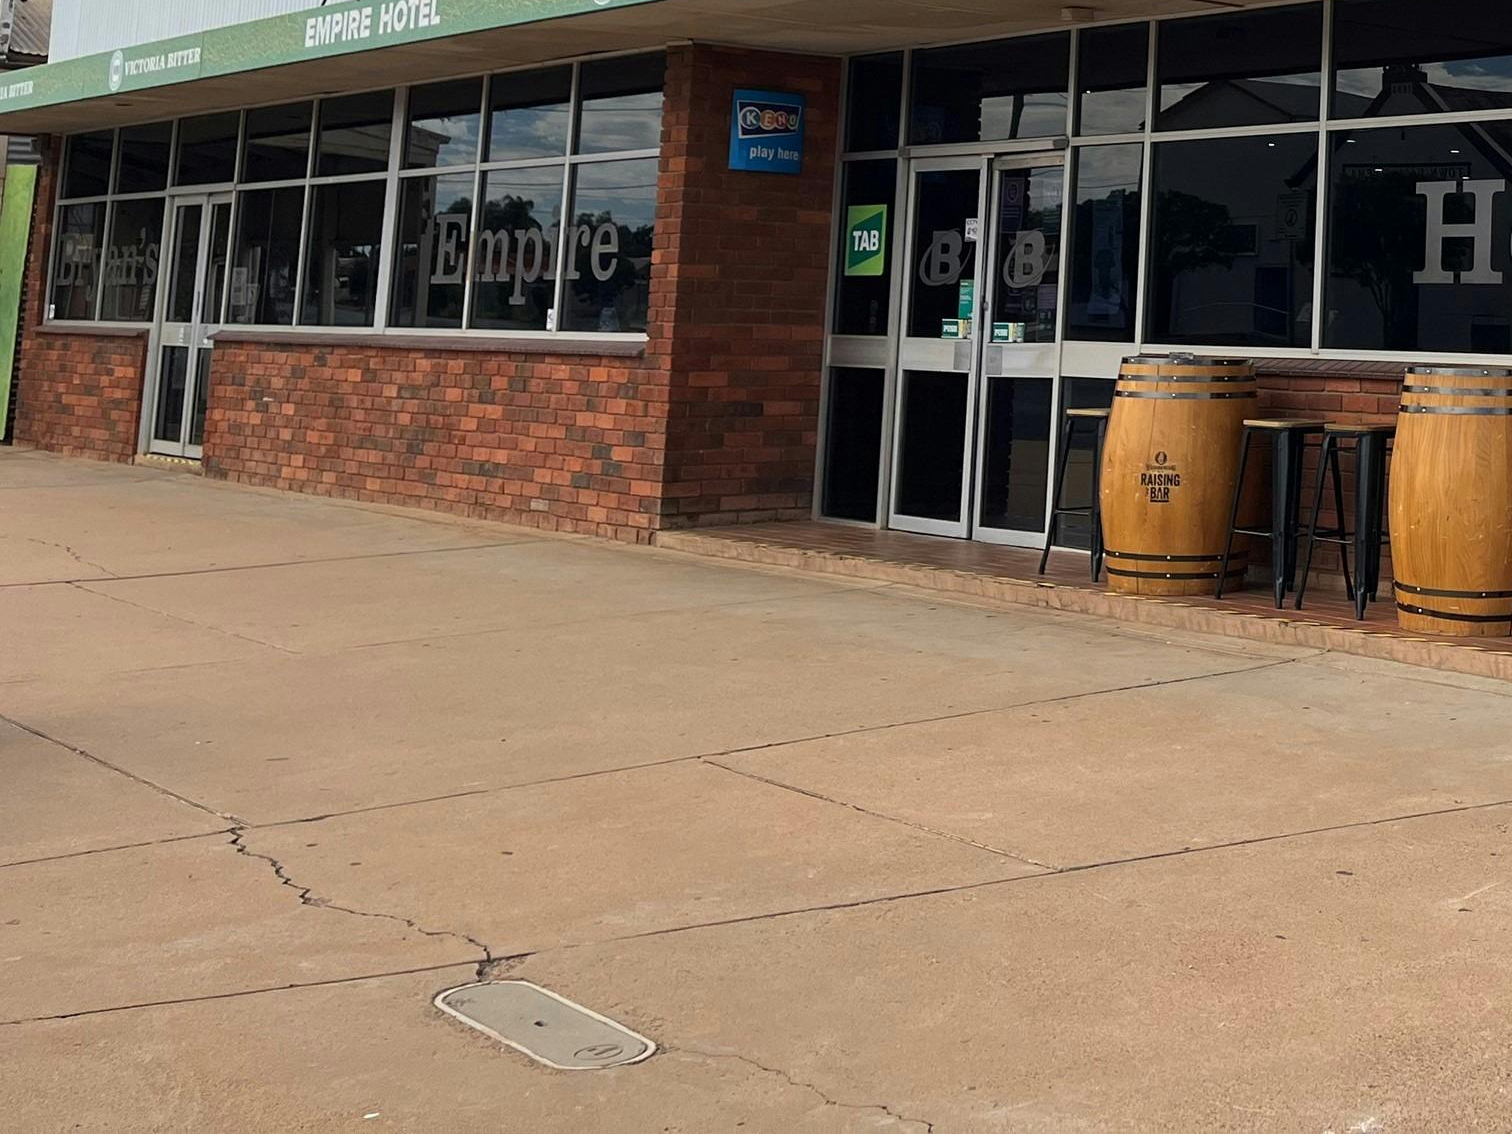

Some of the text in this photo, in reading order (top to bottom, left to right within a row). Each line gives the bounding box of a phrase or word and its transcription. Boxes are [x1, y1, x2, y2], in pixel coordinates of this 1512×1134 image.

[304, 7, 372, 47] EMPIRE
[124, 47, 201, 76] VICTORIA BITTER
[743, 109, 797, 128] KENO
[749, 146, 799, 161] play here
[852, 230, 879, 251] TAB
[1140, 473, 1180, 486] RAISING
[1150, 486, 1170, 499] BAR
